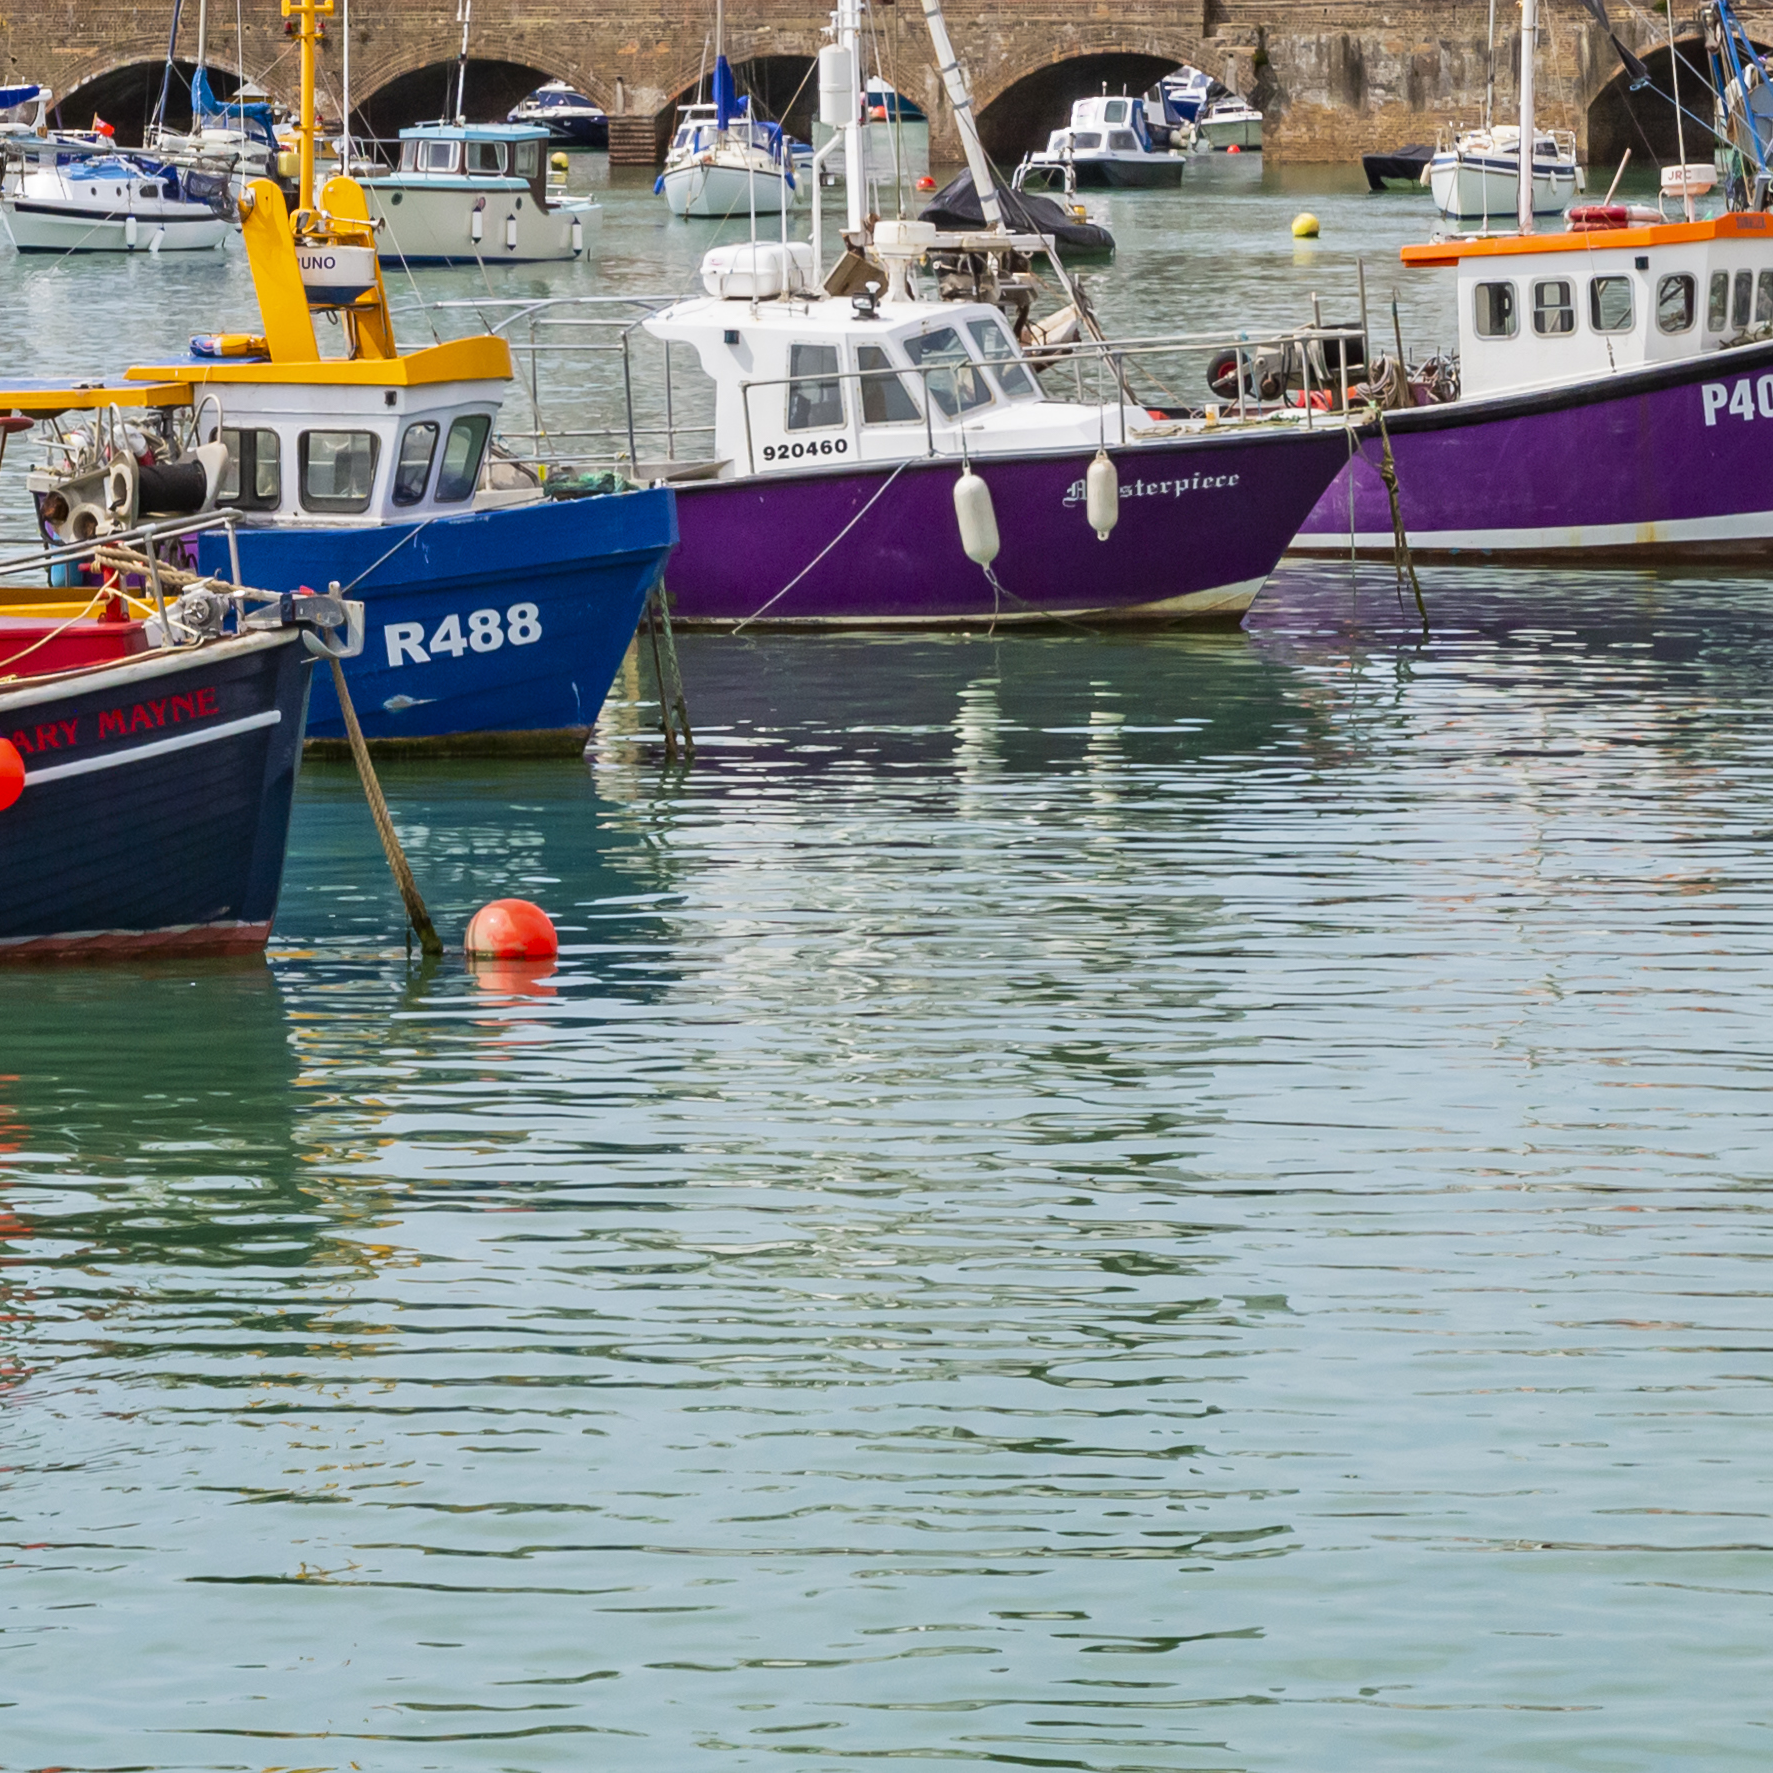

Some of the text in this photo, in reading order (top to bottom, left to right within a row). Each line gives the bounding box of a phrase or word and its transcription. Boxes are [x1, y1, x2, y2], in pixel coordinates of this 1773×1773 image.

[1668, 170, 1692, 181] JRC
[762, 438, 848, 461] 920460
[1062, 471, 1240, 508] Msterpiece
[383, 601, 543, 668] R488
[11, 687, 220, 754] ARY MAYNE
